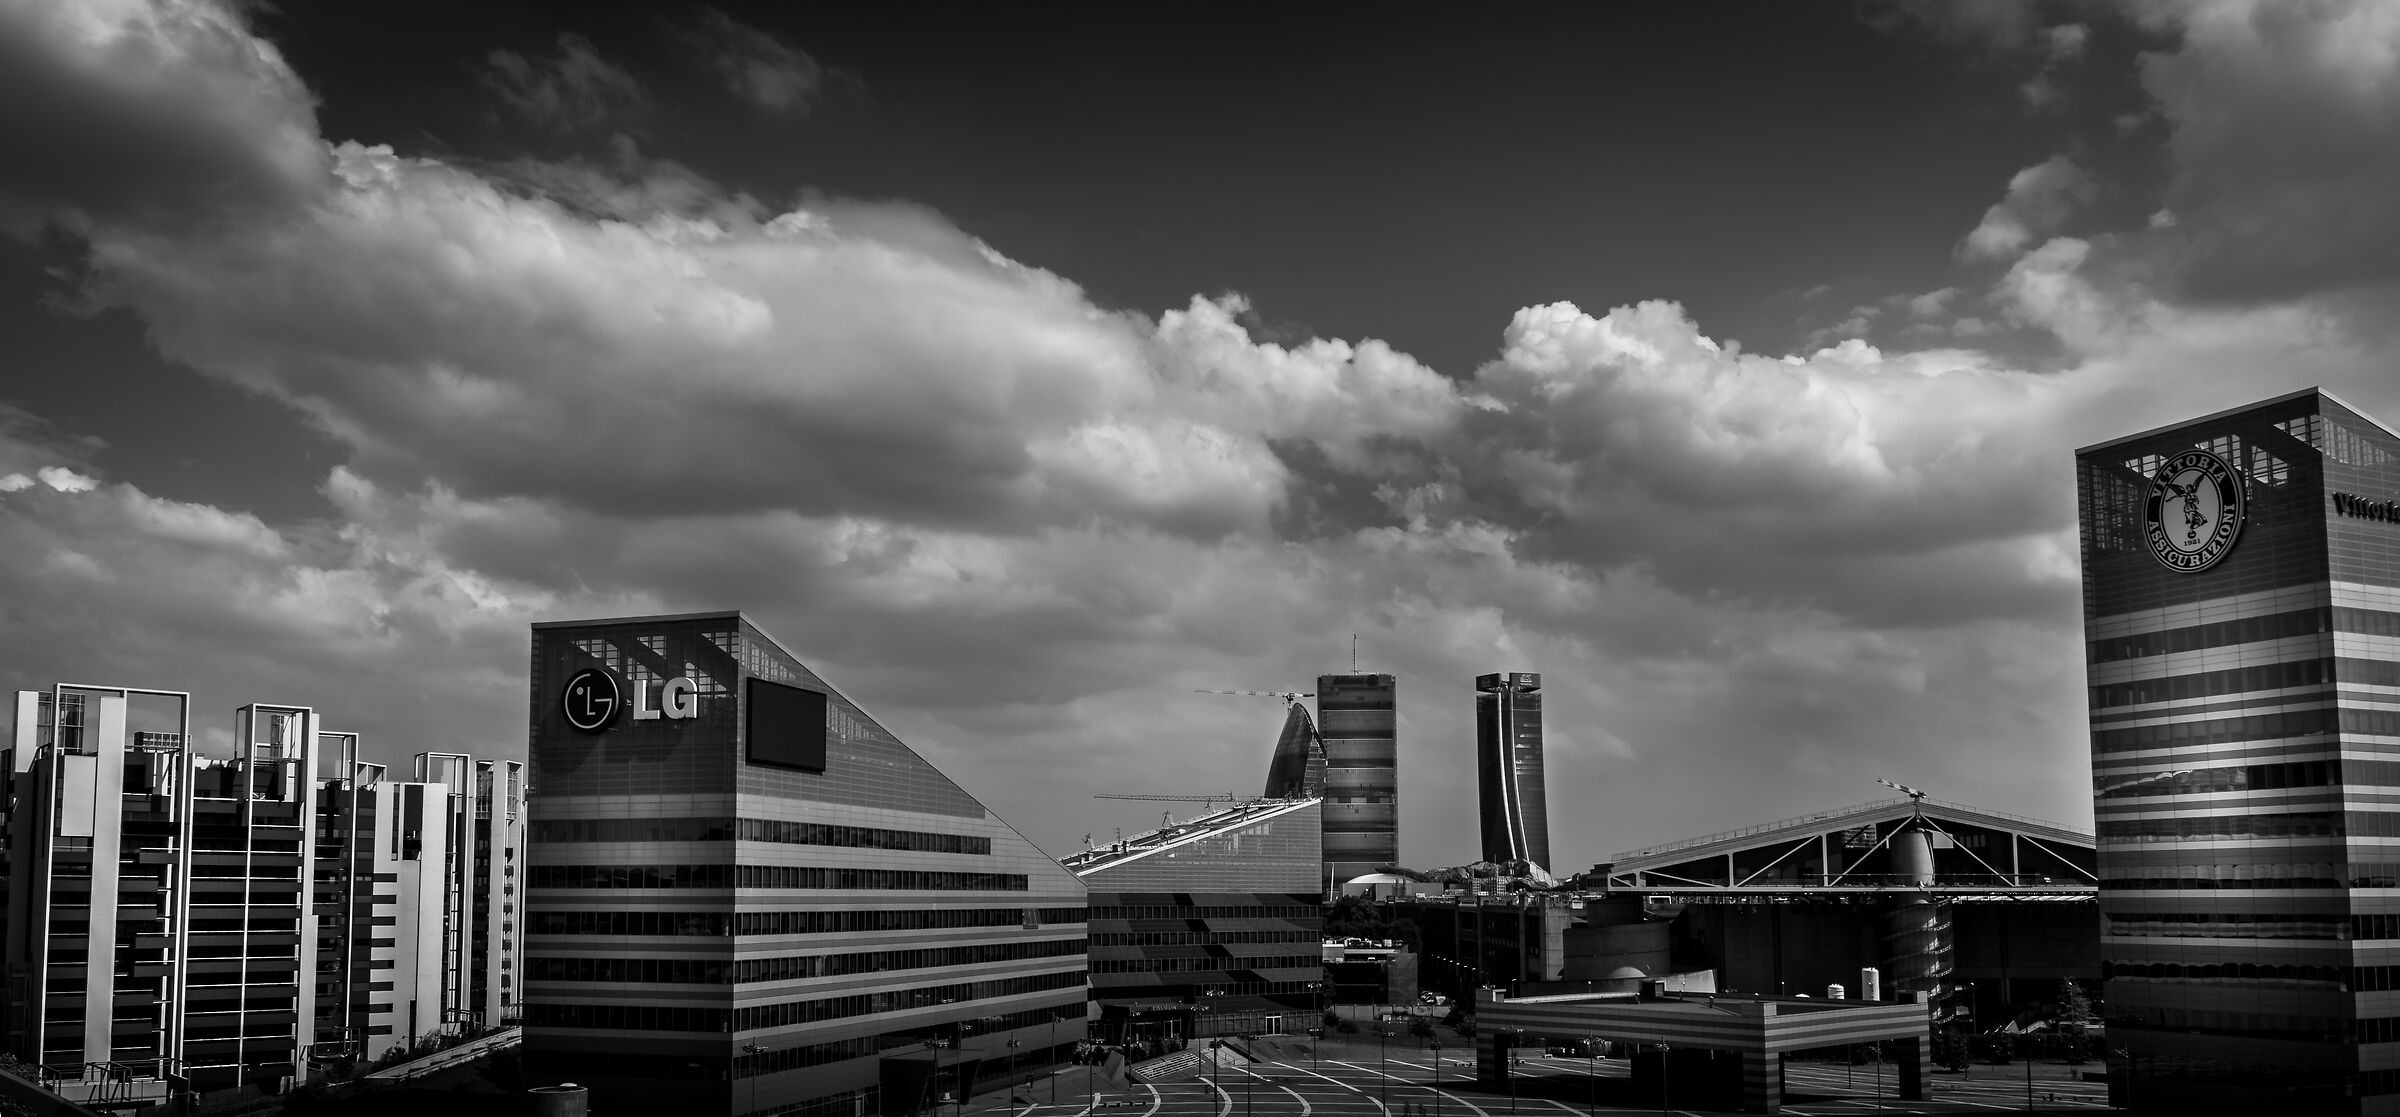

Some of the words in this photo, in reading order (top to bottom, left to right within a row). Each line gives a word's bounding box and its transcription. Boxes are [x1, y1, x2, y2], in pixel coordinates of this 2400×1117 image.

[2150, 455, 2227, 498] VITTORIA
[2148, 503, 2235, 567] ASSICURAZIONI
[2183, 538, 2201, 546] 1921
[633, 676, 697, 720] LG
